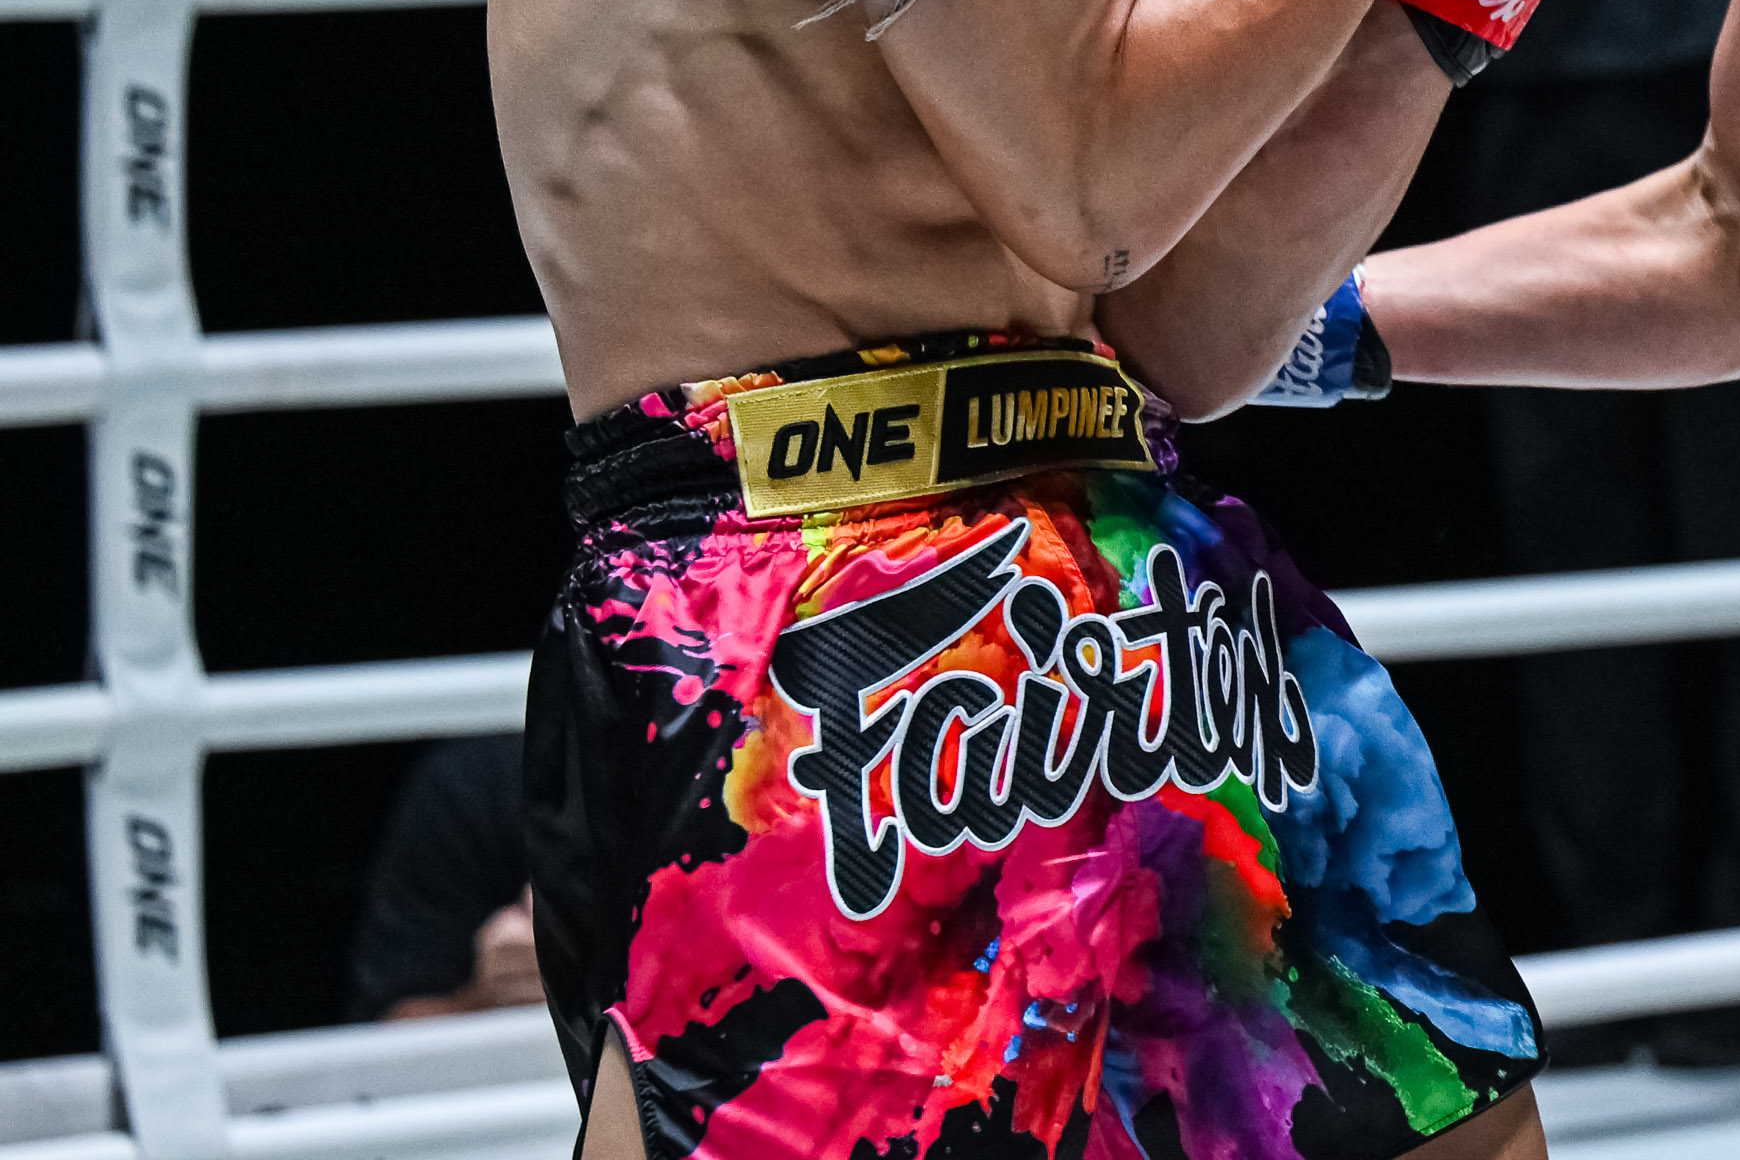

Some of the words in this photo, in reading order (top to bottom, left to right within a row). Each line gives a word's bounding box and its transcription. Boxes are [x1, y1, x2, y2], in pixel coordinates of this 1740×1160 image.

[123, 81, 172, 237] ONE
[767, 402, 920, 482] ONE
[967, 386, 1128, 448] LUMPINEE
[129, 450, 181, 603] ONE
[769, 517, 1319, 921] Fairtex
[125, 812, 182, 969] ONE
